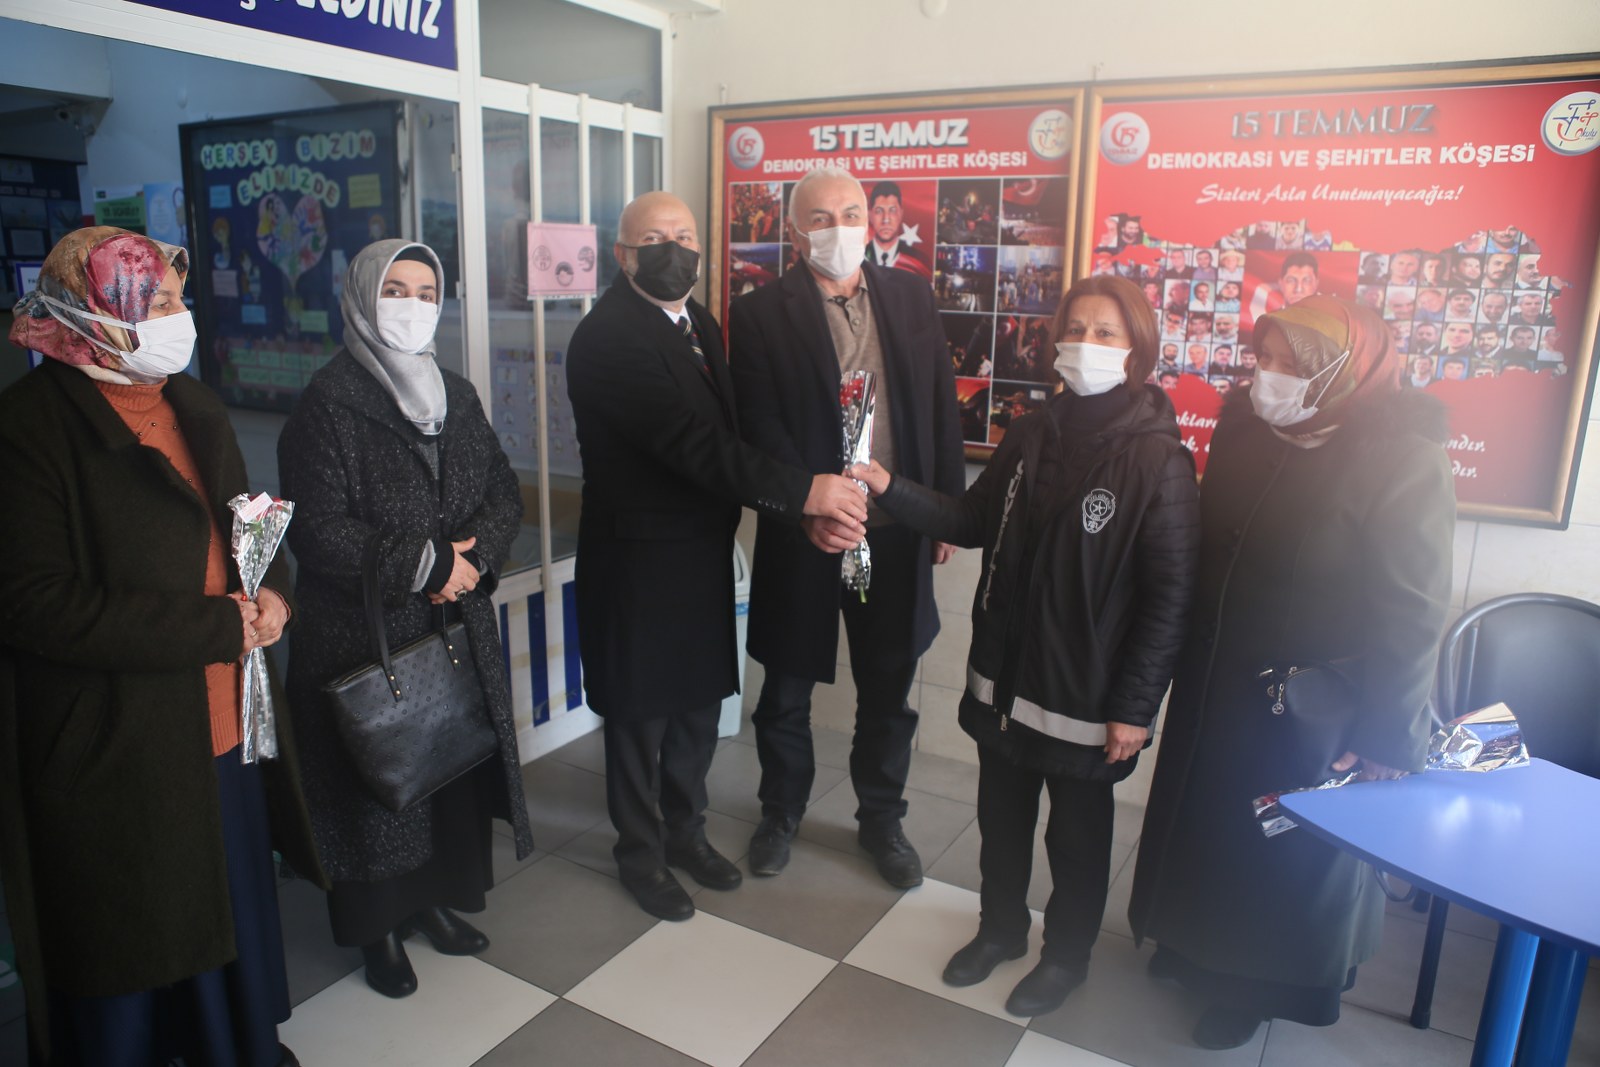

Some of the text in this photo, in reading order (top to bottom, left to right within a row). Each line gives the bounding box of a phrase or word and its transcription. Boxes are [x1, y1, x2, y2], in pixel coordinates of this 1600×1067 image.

[1232, 104, 1437, 138] 15 TEMMUZ
[809, 118, 969, 150] 15 TEMMUZ
[854, 156, 876, 170] VE
[1280, 150, 1309, 167] VE
[1195, 184, 1463, 206] Sizleri Asla Unutmayacağız!
